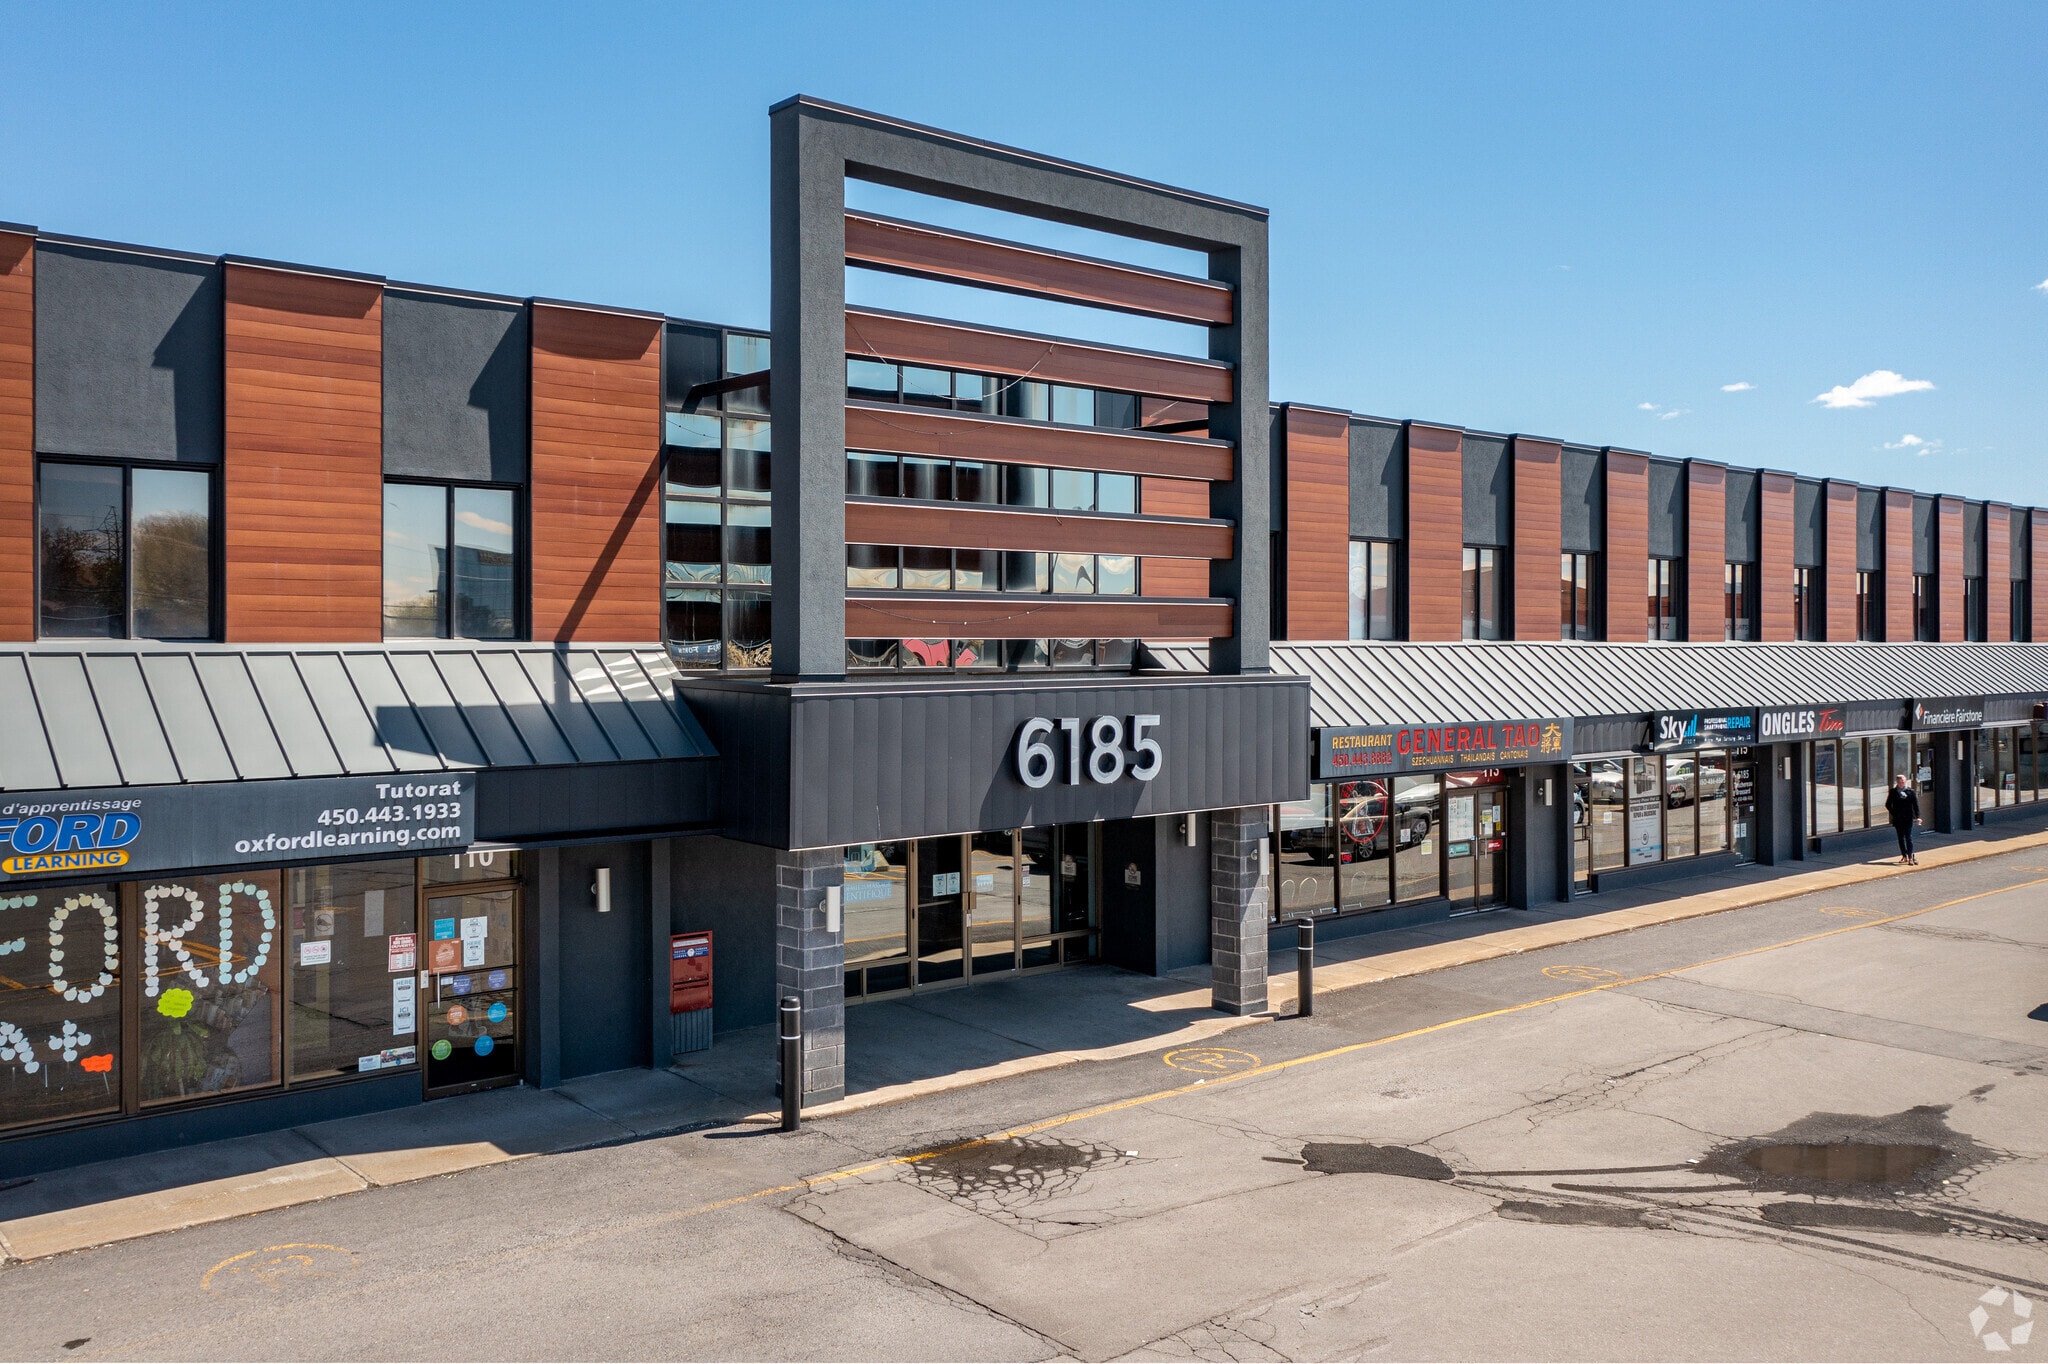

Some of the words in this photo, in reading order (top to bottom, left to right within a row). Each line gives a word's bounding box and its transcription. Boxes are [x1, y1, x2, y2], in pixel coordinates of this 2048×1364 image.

[1727, 716, 1751, 729] REPAIR
[1761, 711, 1815, 736] ONGLES
[1923, 709, 1955, 725] Financière
[1955, 709, 1983, 722] Fairstone
[1397, 725, 1498, 755] GENERAL
[1502, 724, 1541, 748] TAO
[1659, 715, 1687, 745] Sky
[1332, 733, 1393, 750] RESTAURANT
[1018, 714, 1163, 789] 6185
[1411, 754, 1454, 766] SZECHUANNAIS
[1460, 751, 1496, 763] THAILANDAIS
[1500, 750, 1529, 760] CANTONAIS
[376, 780, 461, 799] Tutorat
[3, 799, 142, 816] d'apprentissage
[317, 802, 461, 826] 450.443.1933
[234, 825, 461, 854] oxfordlearning.com
[13, 855, 122, 871] LEARNING
